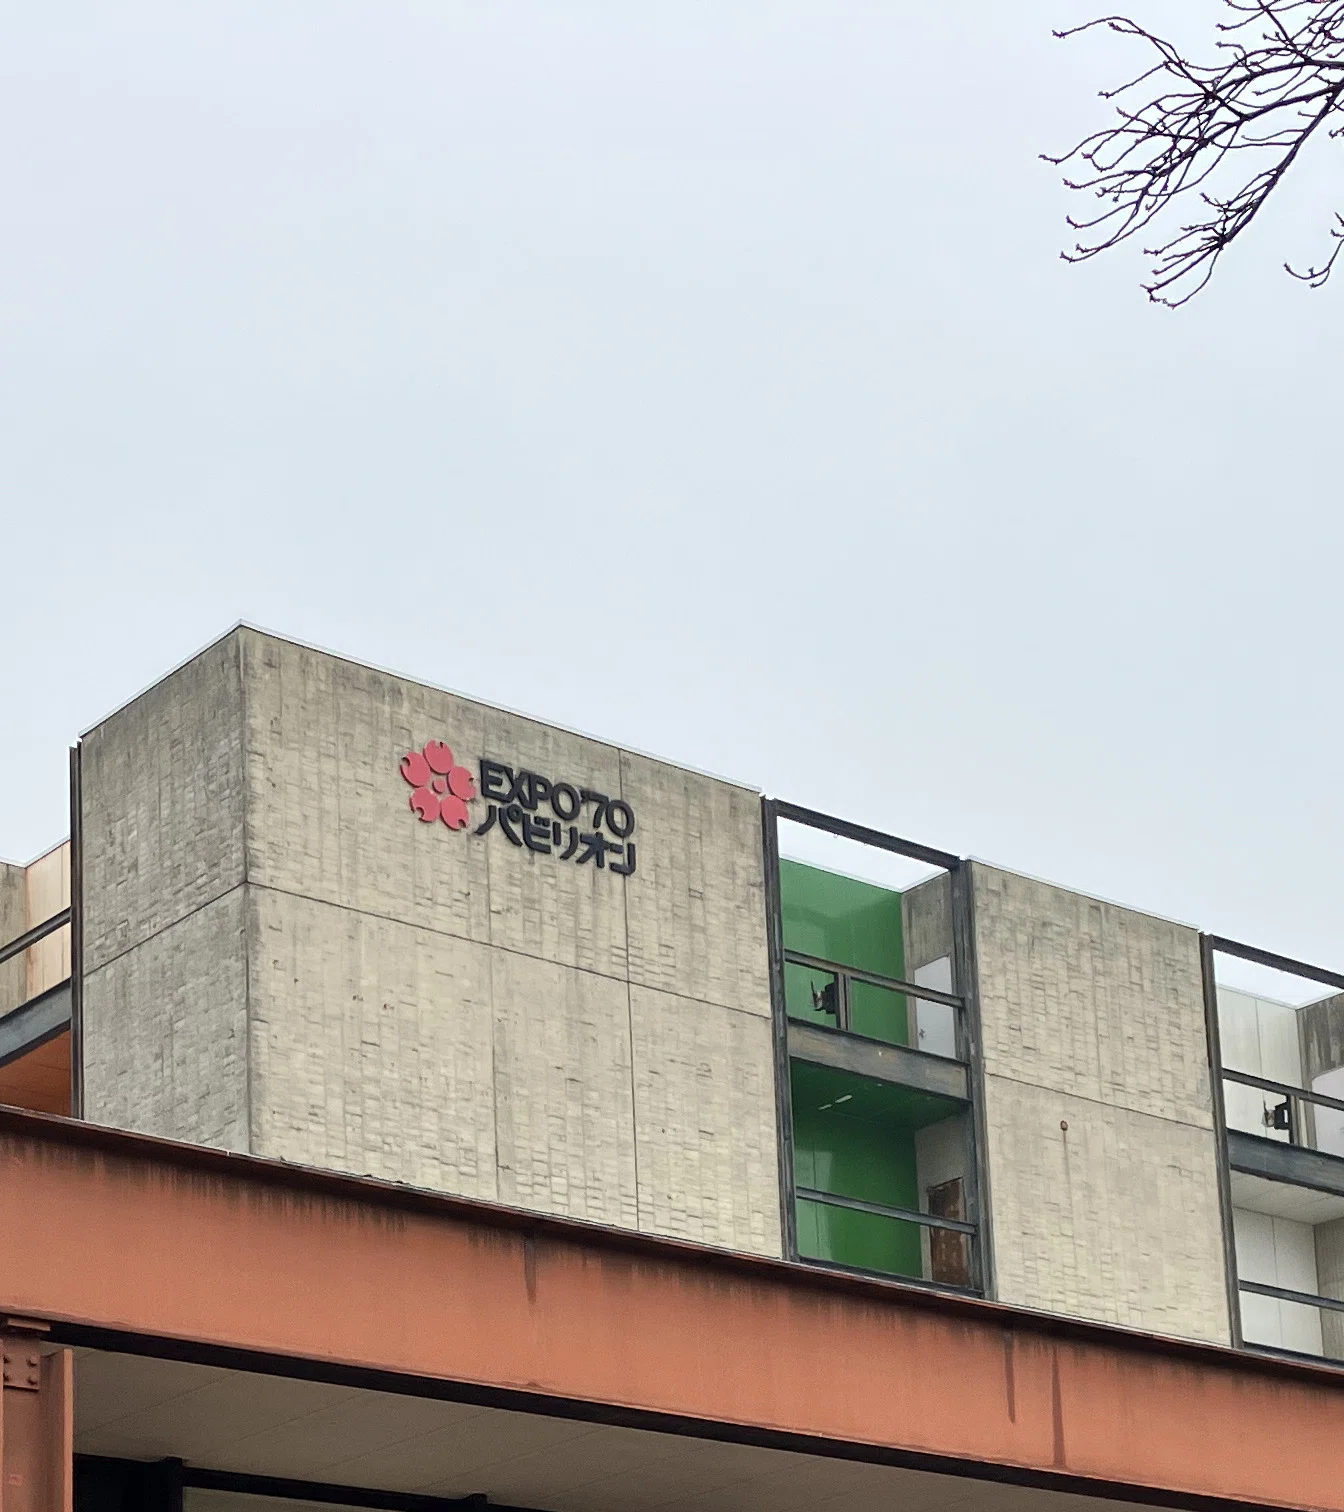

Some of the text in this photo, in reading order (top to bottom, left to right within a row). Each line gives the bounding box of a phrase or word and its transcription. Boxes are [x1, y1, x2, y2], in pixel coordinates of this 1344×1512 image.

[479, 758, 635, 838] EXPO'70
[473, 803, 636, 876] パビリオン
